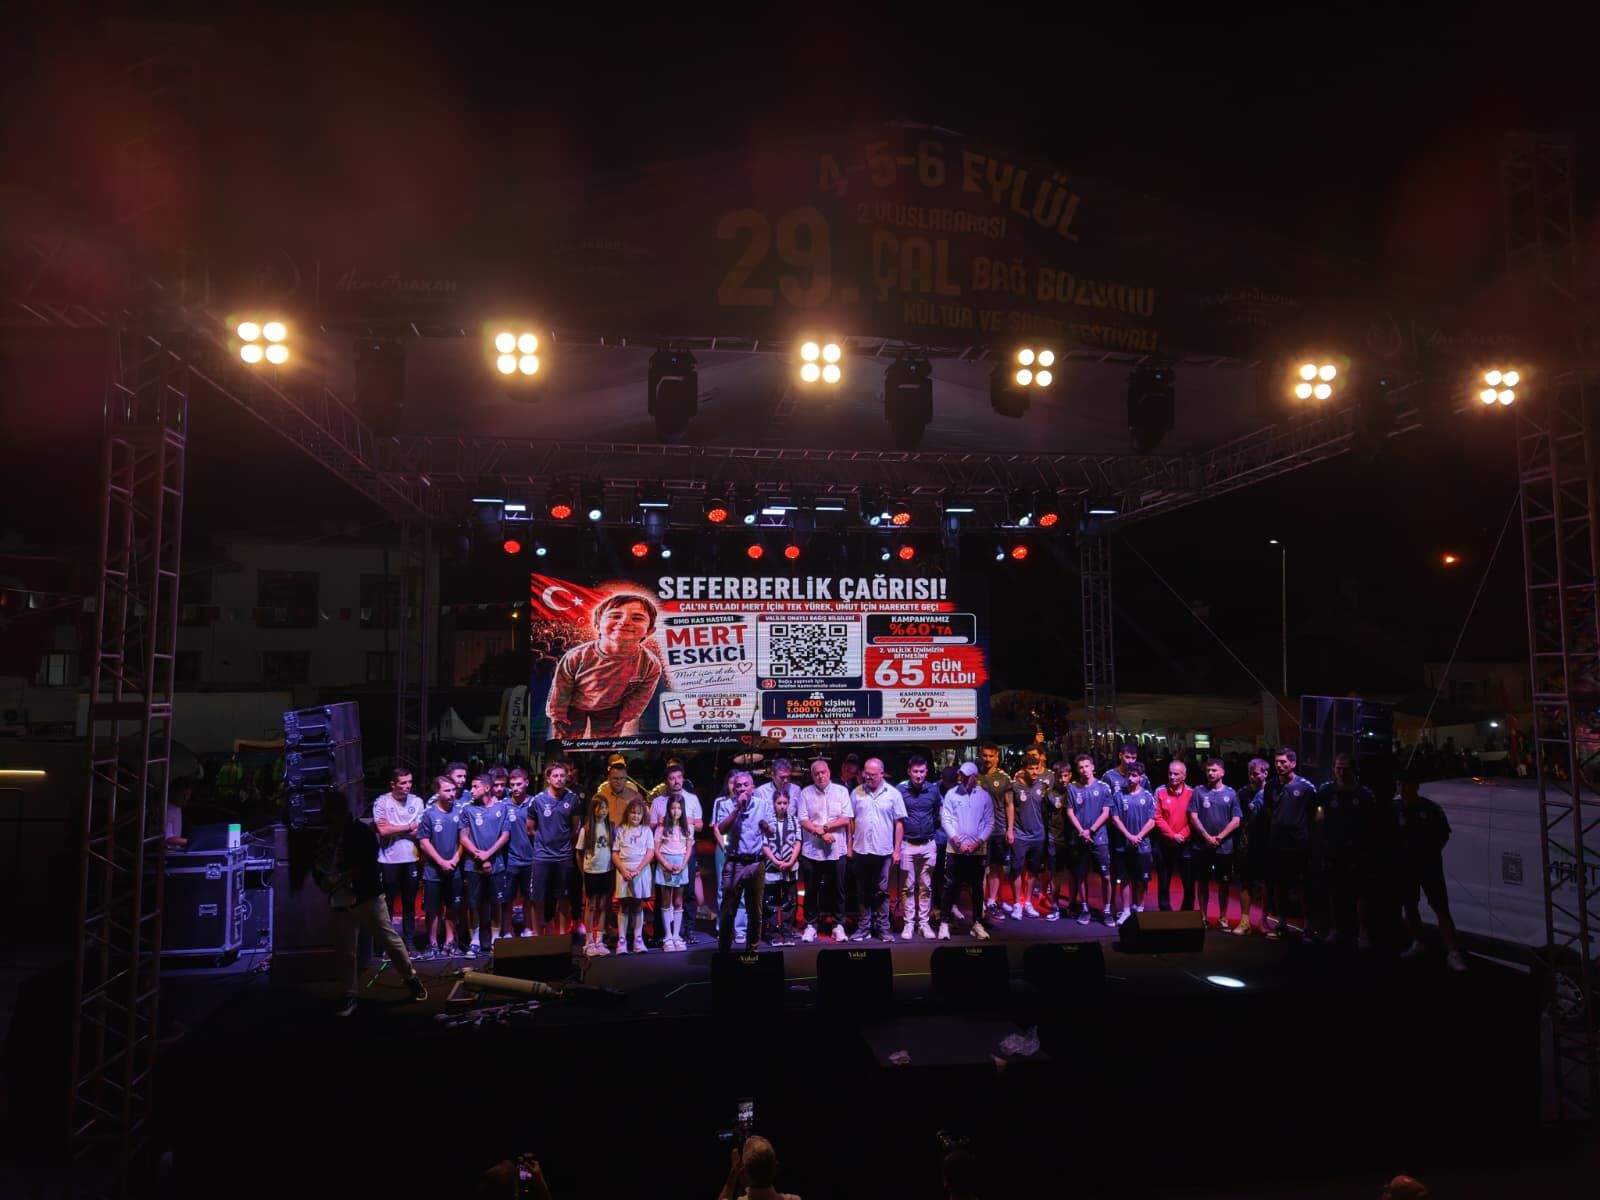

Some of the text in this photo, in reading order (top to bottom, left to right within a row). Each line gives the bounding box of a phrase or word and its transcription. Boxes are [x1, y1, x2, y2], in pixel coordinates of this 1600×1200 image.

[960, 150, 1081, 242] EYLÜL
[715, 205, 860, 309] 29.
[871, 229, 961, 301] ÇAL
[970, 255, 1027, 295] BAĞ
[903, 302, 973, 329] KÜLTÜR
[979, 309, 1001, 332] VE
[658, 574, 947, 602] SEFERBERLİK ÇAĞRISI!
[680, 602, 939, 612] ÇAL'IN EVLADI MERT İÇİN TEK YÜREK, UMUT İÇİN HAREKETE GEÇ!
[891, 615, 950, 623] KAMPANYAMIZ
[666, 625, 748, 648] MERT
[668, 645, 746, 665] ESKİCİ
[931, 658, 962, 672] GÜN
[874, 659, 925, 686] 65
[931, 672, 976, 684] KALDI!
[702, 698, 736, 707] MERT
